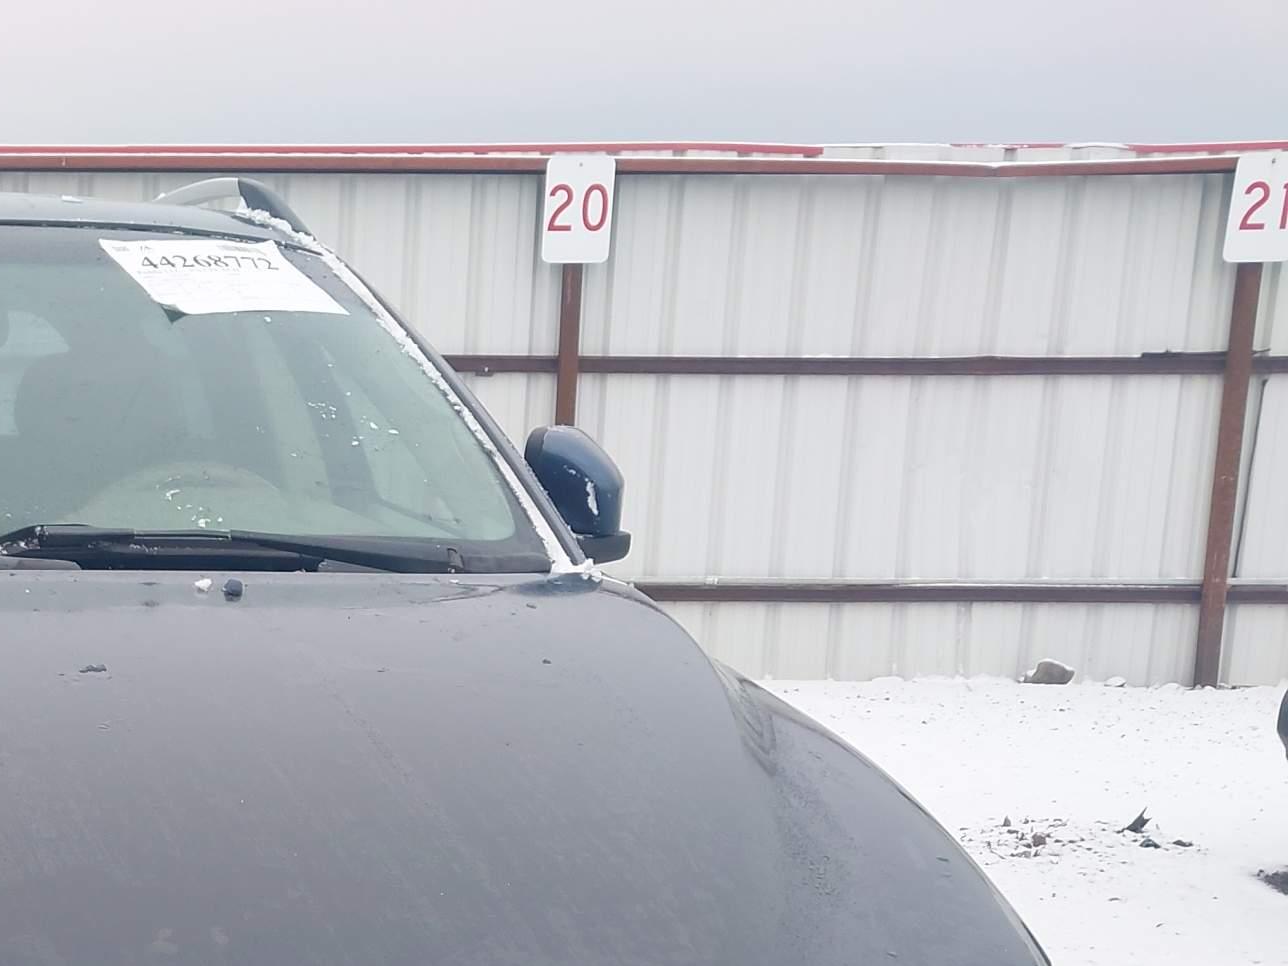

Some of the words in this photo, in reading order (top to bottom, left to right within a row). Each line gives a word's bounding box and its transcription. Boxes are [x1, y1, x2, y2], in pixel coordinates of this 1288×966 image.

[547, 183, 609, 231] 20
[1239, 181, 1288, 230] 21
[140, 254, 280, 270] 44268772
